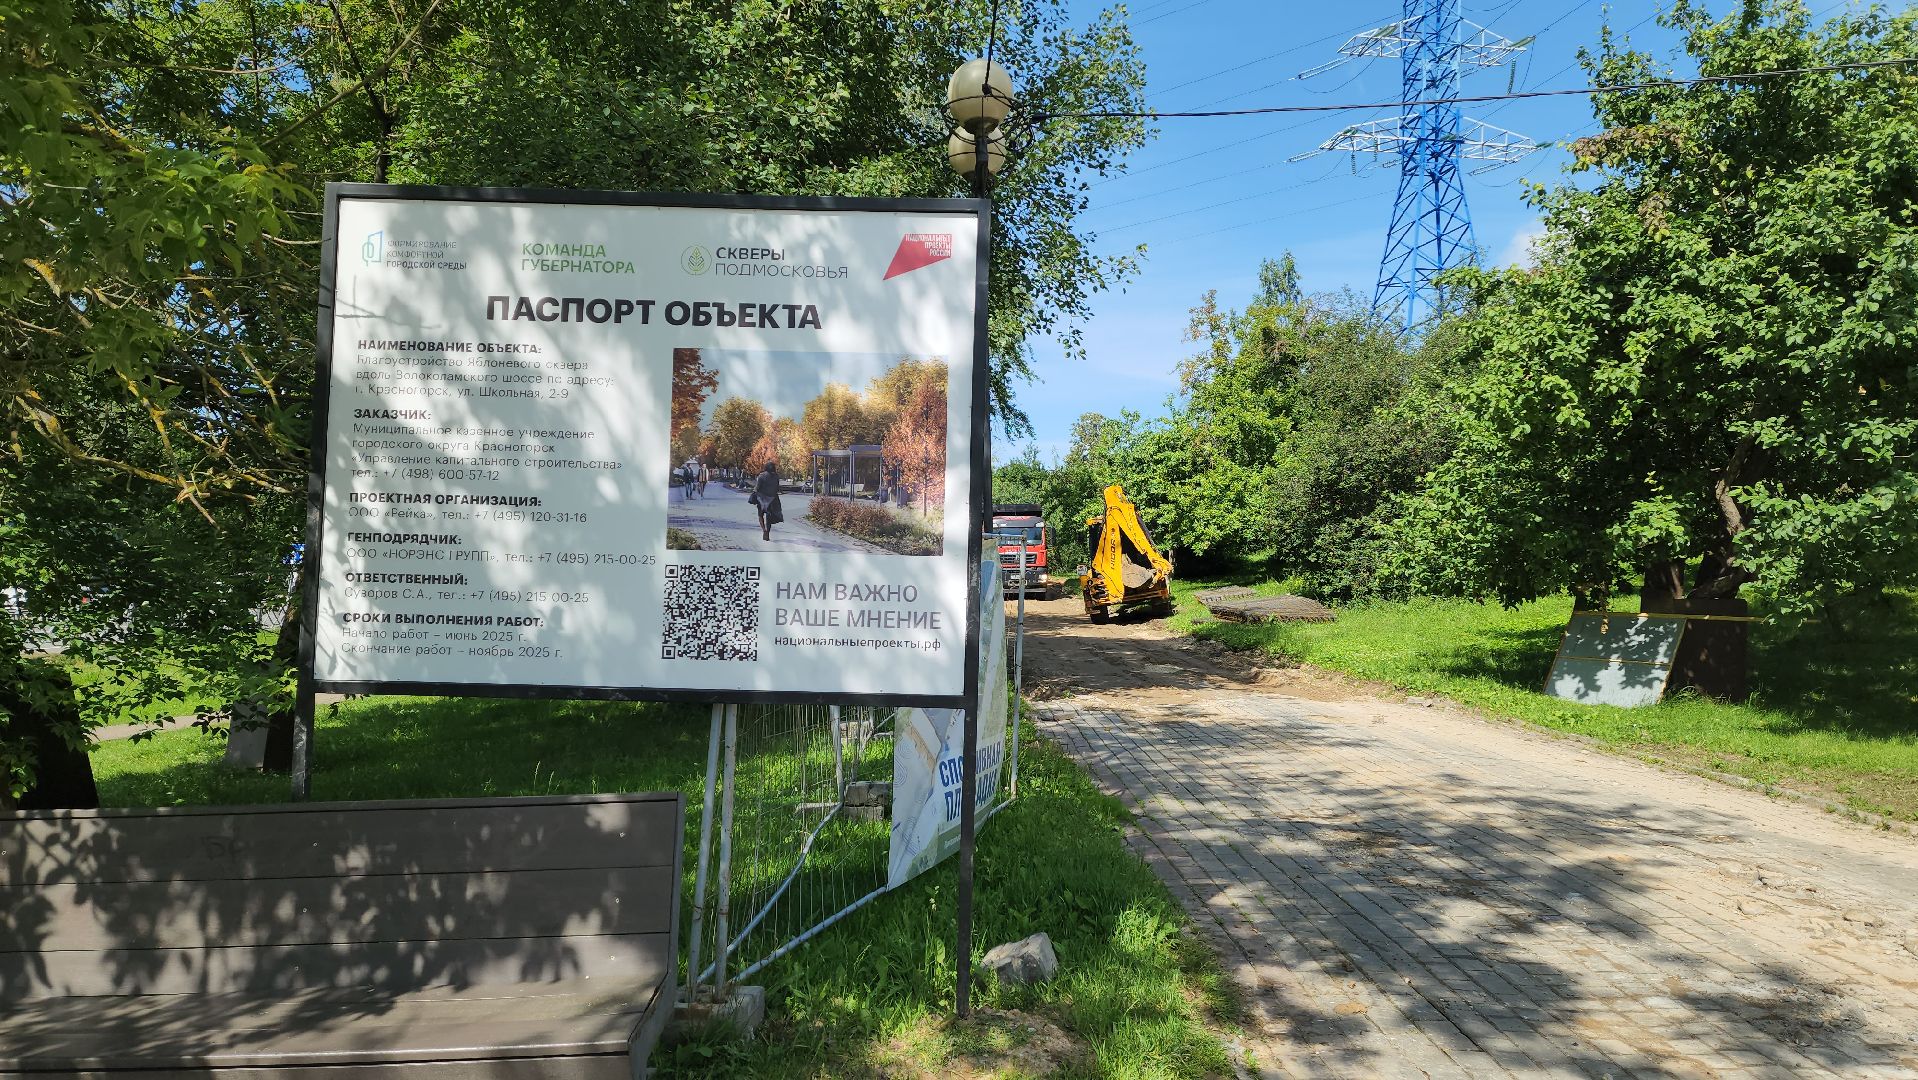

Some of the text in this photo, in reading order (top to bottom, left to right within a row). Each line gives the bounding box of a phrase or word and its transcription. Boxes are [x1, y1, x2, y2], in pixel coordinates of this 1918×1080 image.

[386, 250, 444, 259] КОМФОРТНОЙ
[522, 242, 606, 258] КОМАНДА
[716, 247, 785, 260] СКВЕРЫ
[386, 260, 467, 270] ГОРОДСКОЙ СРЕДЫ
[521, 258, 636, 274] ГУБЕРНАТОРА
[715, 263, 848, 279] ПОДМОСКОВЬЯ
[486, 295, 823, 330] ПАСПОРТ ОБЪЕКТА
[357, 340, 542, 354] НАИМЕНОВАНИЕ ОБЪЕКТА:
[357, 354, 588, 372] Благоустройство Яблоневого сквера
[356, 370, 615, 388] вдоль Волоколамского шоссе по адресу:
[368, 384, 452, 398] Красногорск,
[457, 388, 474, 398] ул.
[479, 387, 544, 400] Школьная,
[548, 389, 569, 399] 2-9
[353, 408, 432, 420] ЗАКАЗЧИК:
[353, 422, 595, 441] Муниципальное казенное учреждение
[352, 440, 556, 455] городского округа Красногорск
[351, 452, 622, 472] «Управление капитального строительства»
[351, 470, 378, 478] тел.:
[401, 468, 434, 480] (498)
[438, 469, 500, 481] 600-57-12
[349, 492, 542, 508] ПРОЕКТНАЯ ОРГАНИЗАЦИЯ:
[348, 506, 587, 523] ООО «Рейка», тел.: +7 (495) 120-31-16
[347, 532, 462, 546] ГЕНПОДРЯДЧИК:
[346, 548, 377, 558] ООО
[382, 548, 445, 560] «НОРЭНС
[504, 553, 533, 563] тел.:
[537, 553, 552, 562] +7
[556, 552, 589, 566] (495)
[594, 554, 656, 566] 215-00-25
[345, 572, 468, 586] ОТВЕТСТВЕННЫЙ:
[344, 587, 398, 600] Суворов
[470, 590, 485, 600] +7
[489, 590, 522, 604] (495)
[526, 592, 589, 603] 21500-25
[776, 582, 918, 602] НАМ ВАЖНО
[342, 612, 544, 628] СРОКИ ВЫПОЛНЕНИЯ РАБОТ:
[774, 608, 942, 630] ВАШЕ МНЕНИЕ
[342, 628, 387, 638] Начало
[392, 628, 429, 641] работ
[445, 632, 478, 641] июнь
[482, 631, 514, 642] 2025
[518, 634, 527, 642] г.
[415, 644, 451, 657] работ
[468, 645, 514, 659] ноябрь
[518, 646, 550, 658] 2025
[554, 650, 564, 658] г.
[774, 636, 942, 652] национальныепроекты.рф
